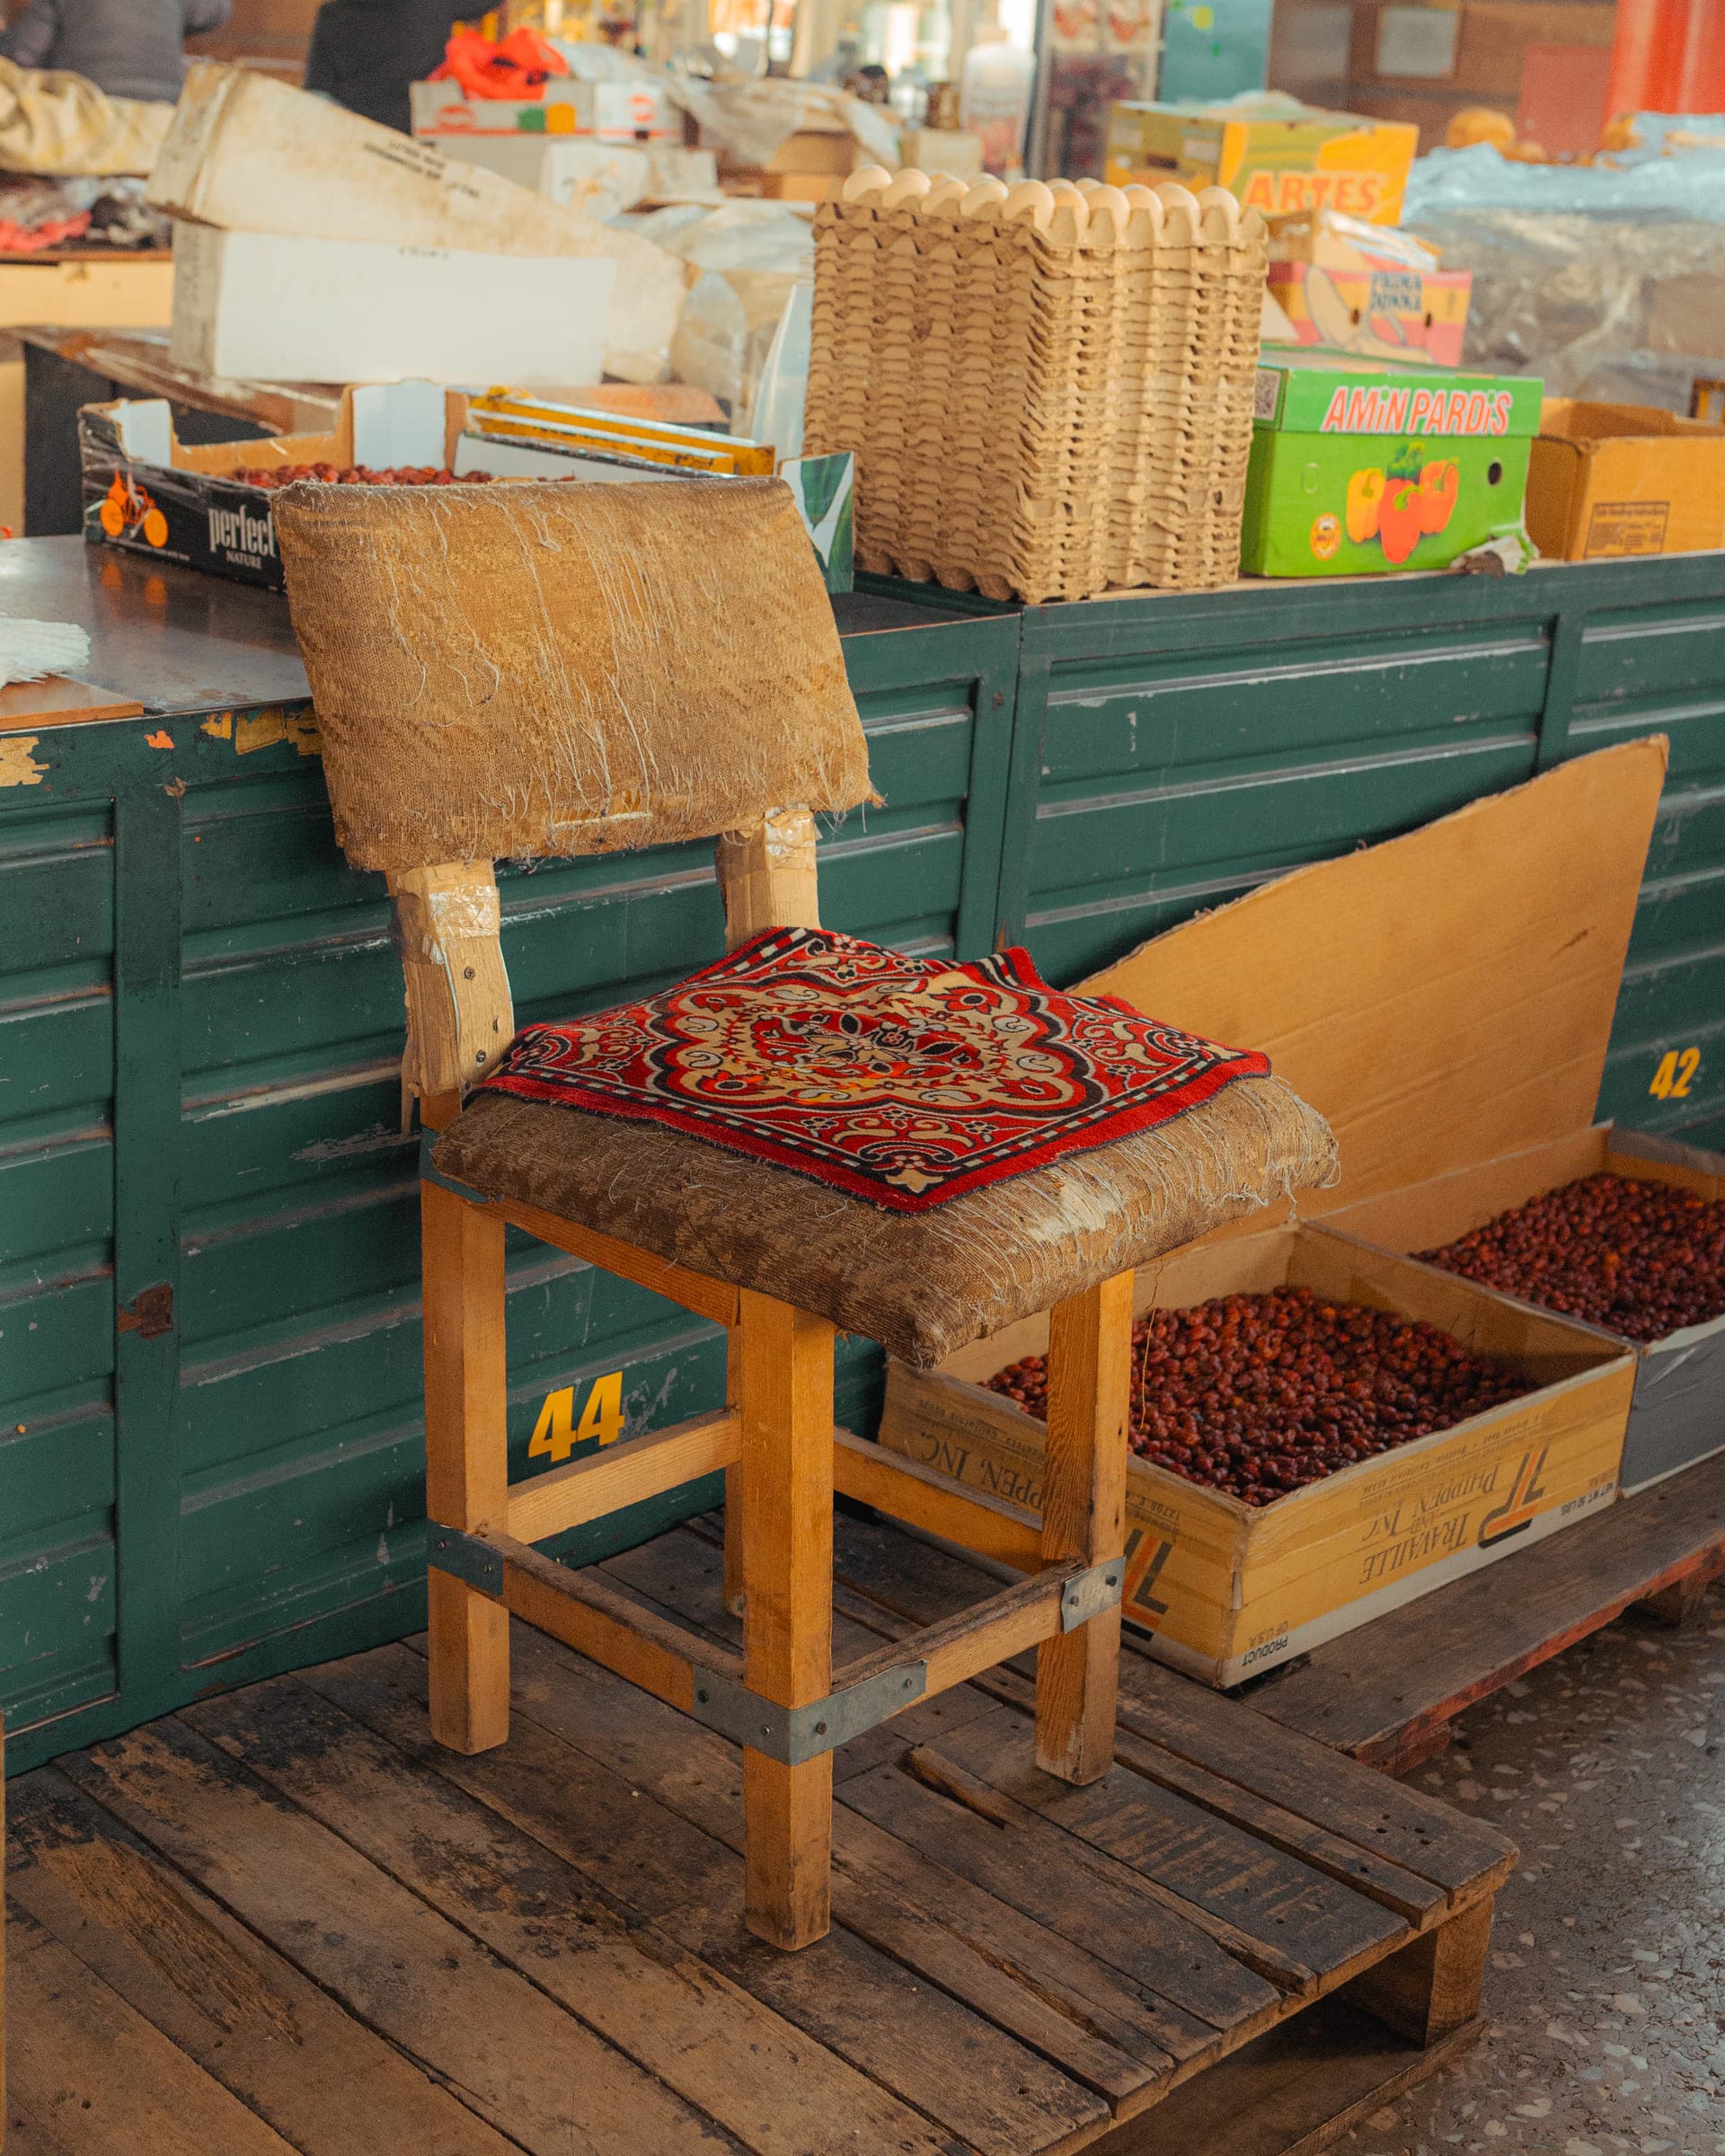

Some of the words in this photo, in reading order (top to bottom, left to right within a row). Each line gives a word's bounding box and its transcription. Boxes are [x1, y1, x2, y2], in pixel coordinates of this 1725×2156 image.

[1244, 172, 1381, 215] ARTES
[208, 505, 276, 558] perfect
[226, 550, 262, 570] NATURE
[1649, 1046, 1701, 1100] 42
[527, 1371, 625, 1462] 44
[921, 1432, 970, 1481] INC.
[1359, 1512, 1470, 1585] TRAVAILLE
[1242, 1635, 1288, 1667] PRODUCT
